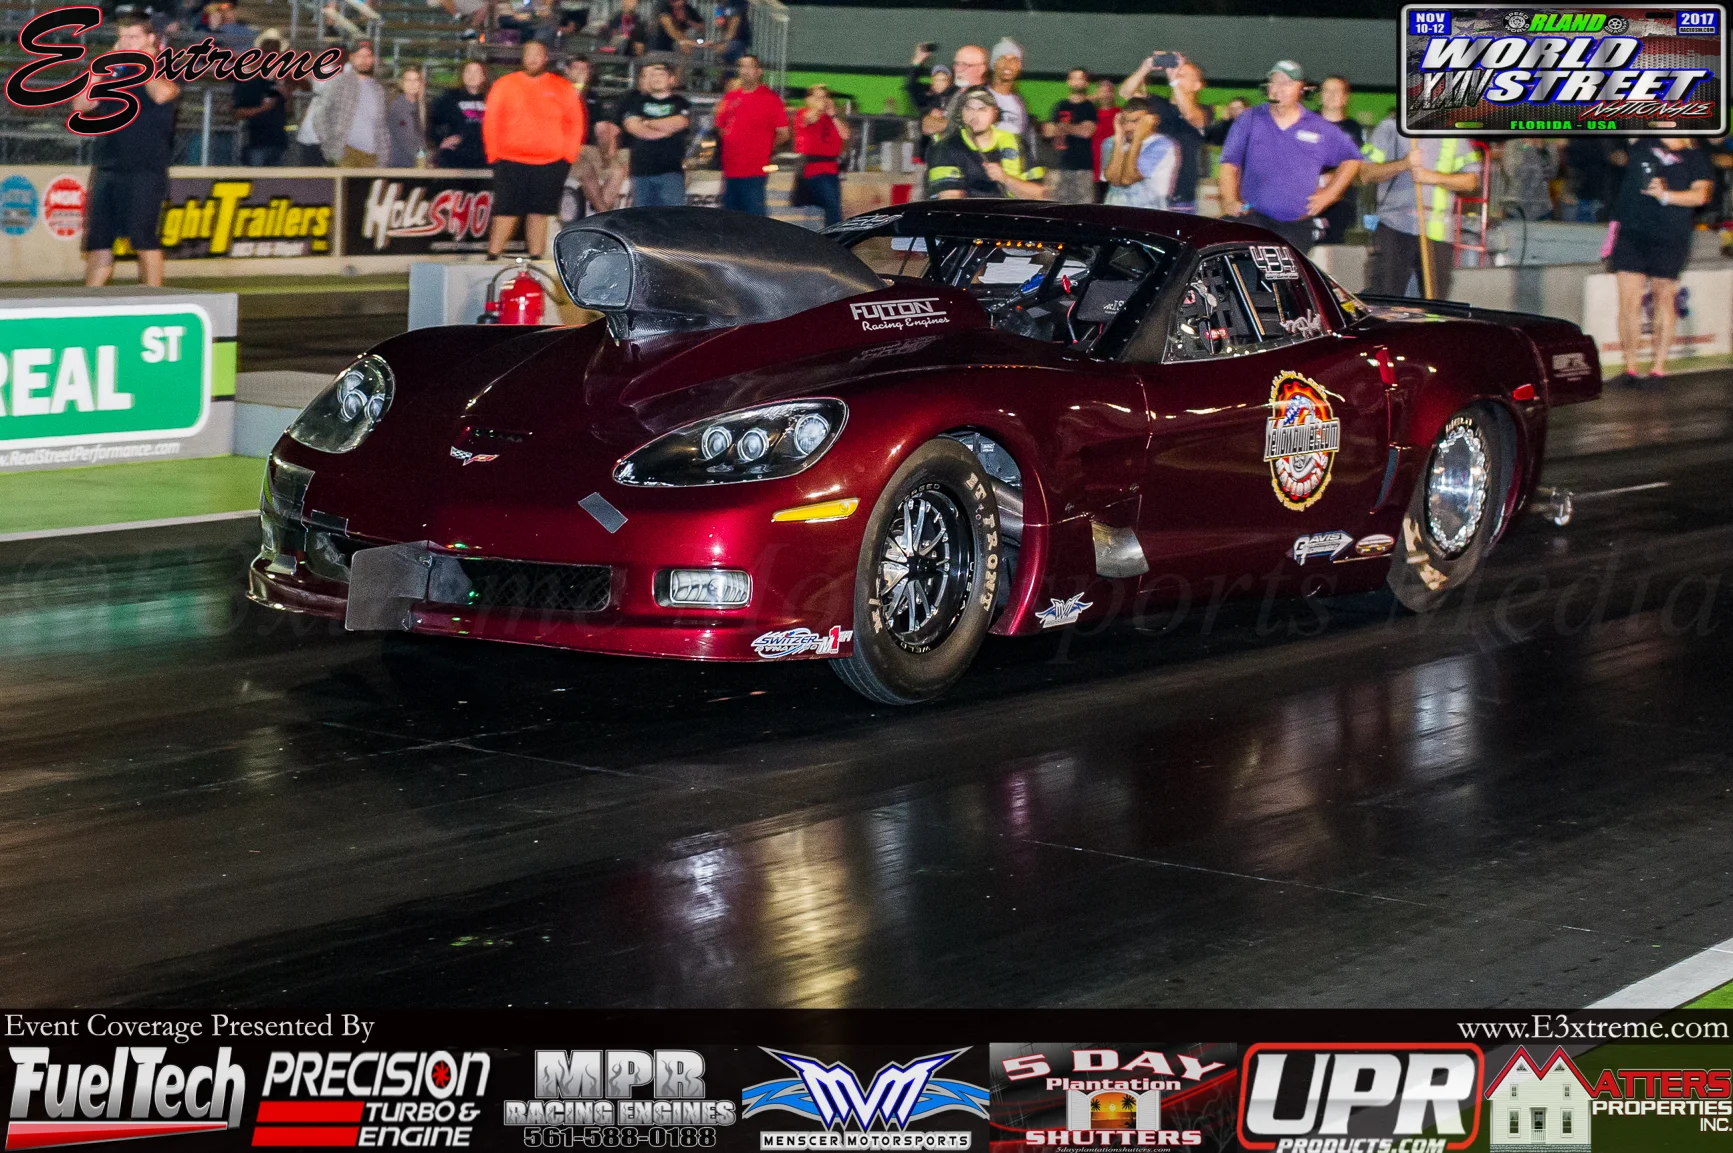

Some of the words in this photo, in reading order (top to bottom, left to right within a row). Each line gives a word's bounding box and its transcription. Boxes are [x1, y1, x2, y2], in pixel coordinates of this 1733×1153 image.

[850, 298, 947, 320] FULTON
[862, 320, 904, 331] Racing
[905, 316, 950, 328] Engines
[0, 345, 134, 417] EAL
[141, 326, 185, 363] ST
[980, 514, 999, 612] FRONT
[761, 634, 818, 644] SWITZER
